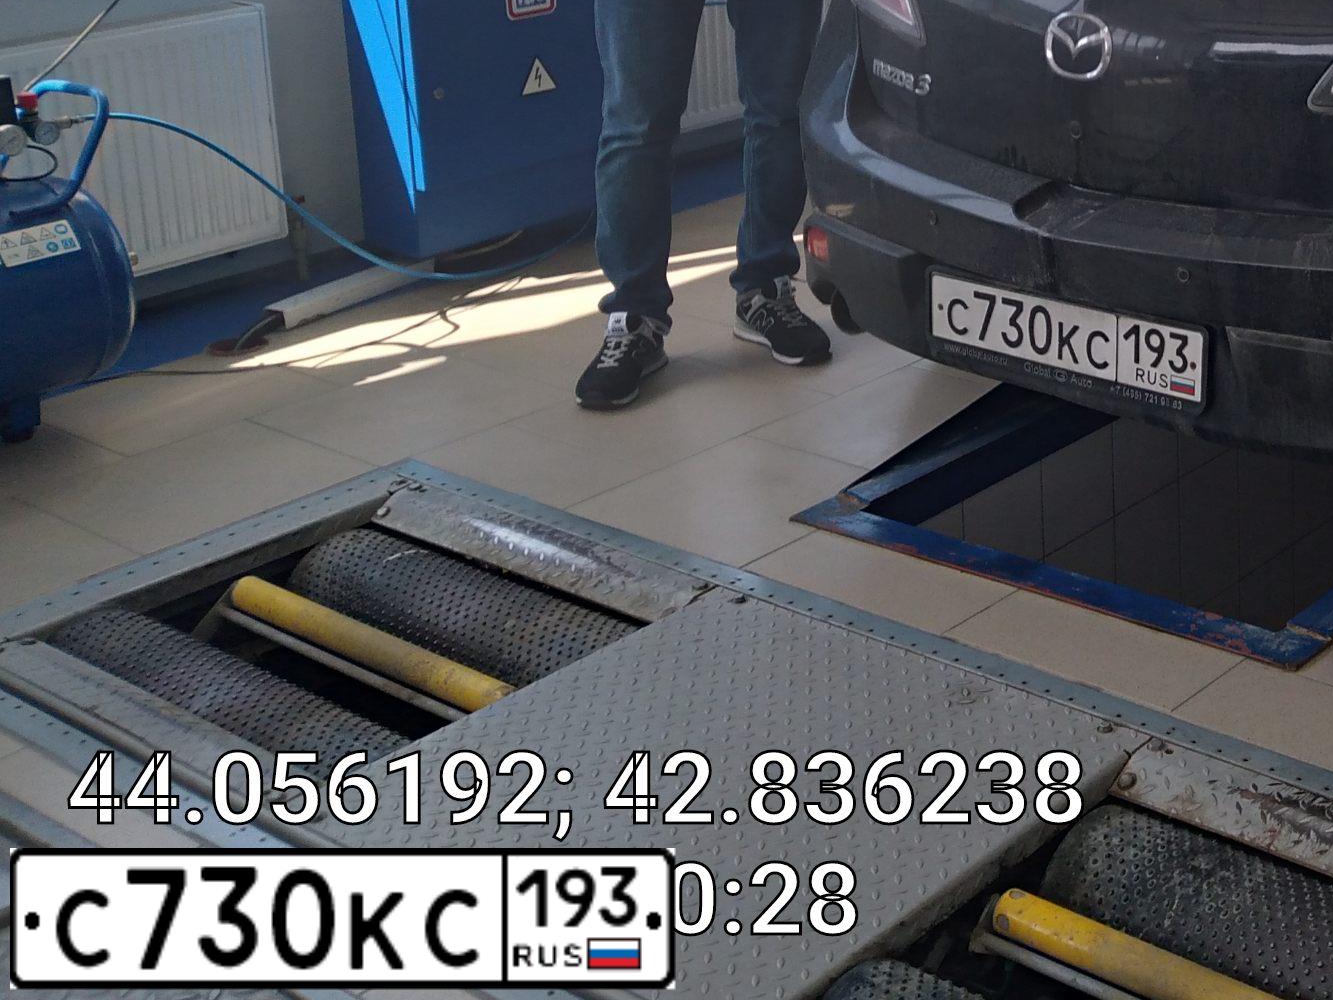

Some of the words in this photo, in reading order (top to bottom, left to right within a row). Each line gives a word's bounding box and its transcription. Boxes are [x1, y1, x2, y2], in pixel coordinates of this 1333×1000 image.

[915, 73, 931, 96] 3
[1122, 324, 1188, 374] 193
[1070, 373, 1093, 388] Auto
[1135, 367, 1169, 388] RUS
